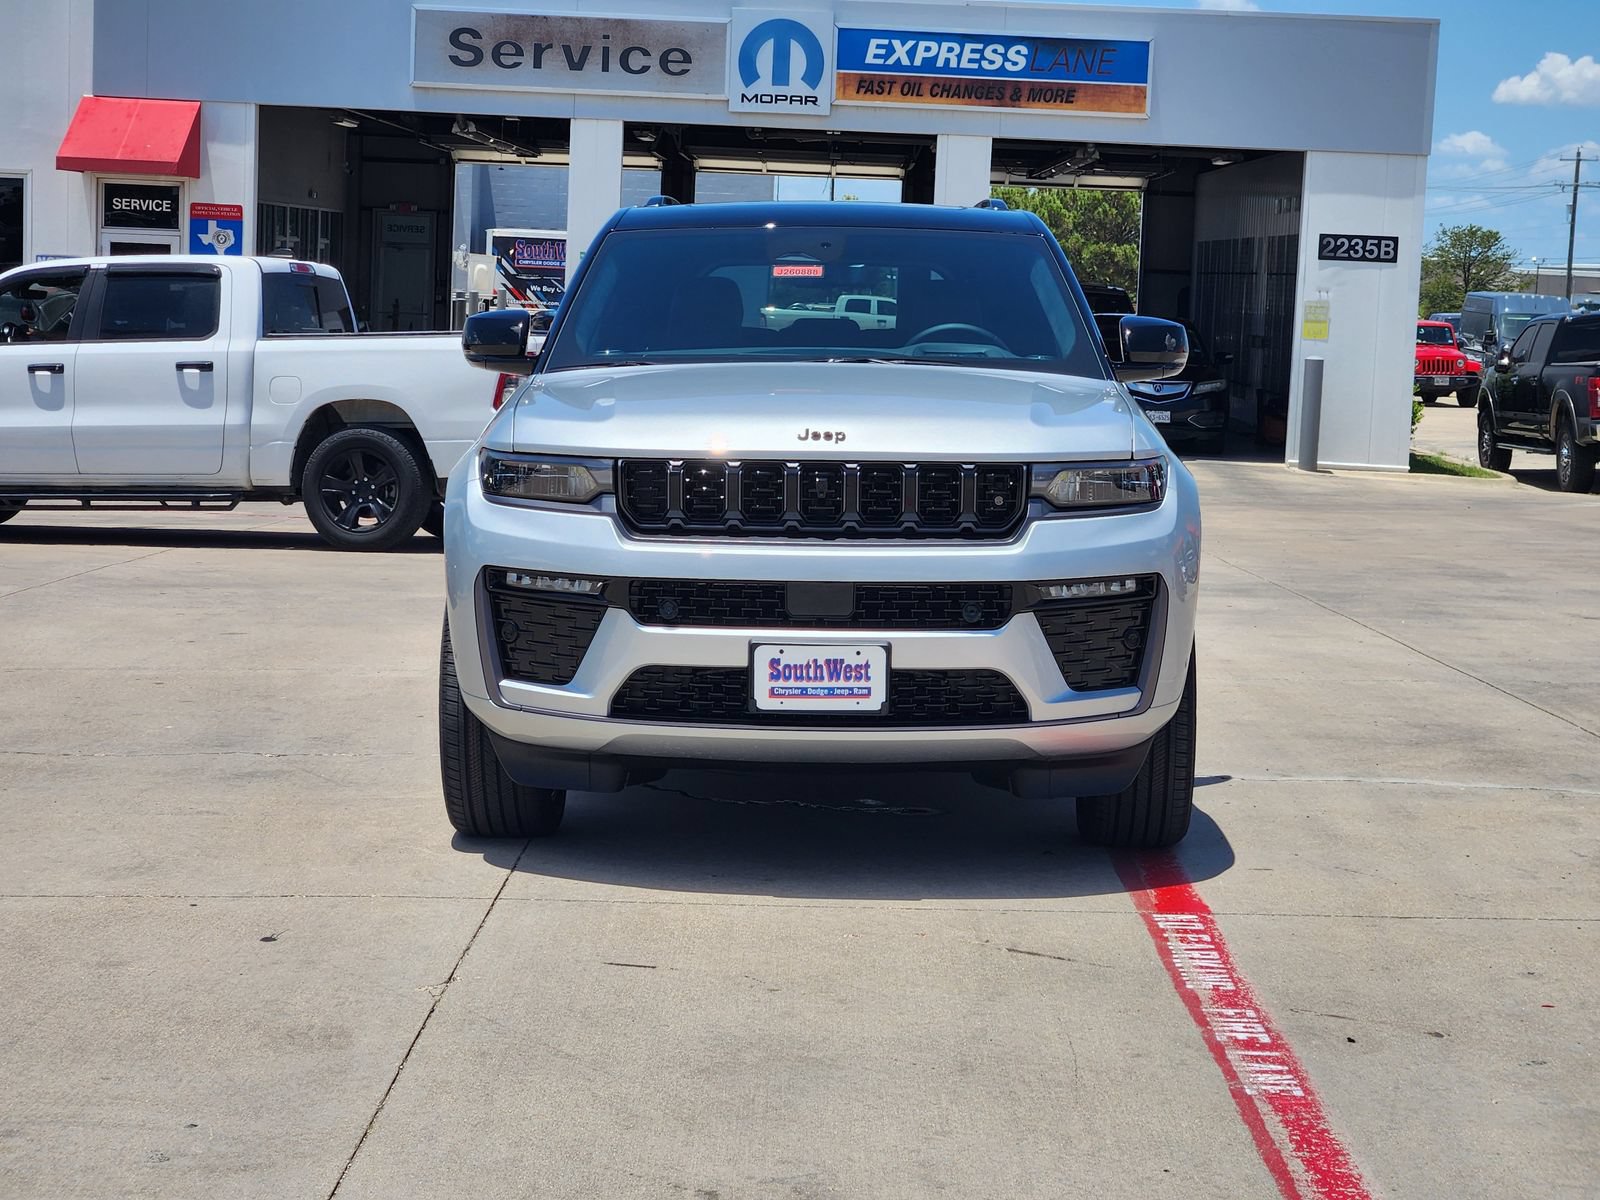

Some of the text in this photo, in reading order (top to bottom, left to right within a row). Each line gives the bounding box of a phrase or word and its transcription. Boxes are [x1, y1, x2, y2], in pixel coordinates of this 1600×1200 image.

[448, 27, 692, 76] Service
[741, 92, 818, 106] MOPAR
[856, 79, 1077, 104] FAST OIL CHANGES & MORE
[112, 197, 172, 212] SERVICE
[1321, 237, 1395, 260] 2235B
[542, 286, 556, 294] Buy
[797, 428, 847, 444] Jeep
[768, 657, 871, 682] SouthWest
[774, 687, 801, 695] Chrysler
[807, 688, 829, 696] Dodge
[833, 688, 849, 697] Jeep
[1152, 913, 1236, 989] NO PARKING
[1202, 1008, 1304, 1096] FIRE LANE
